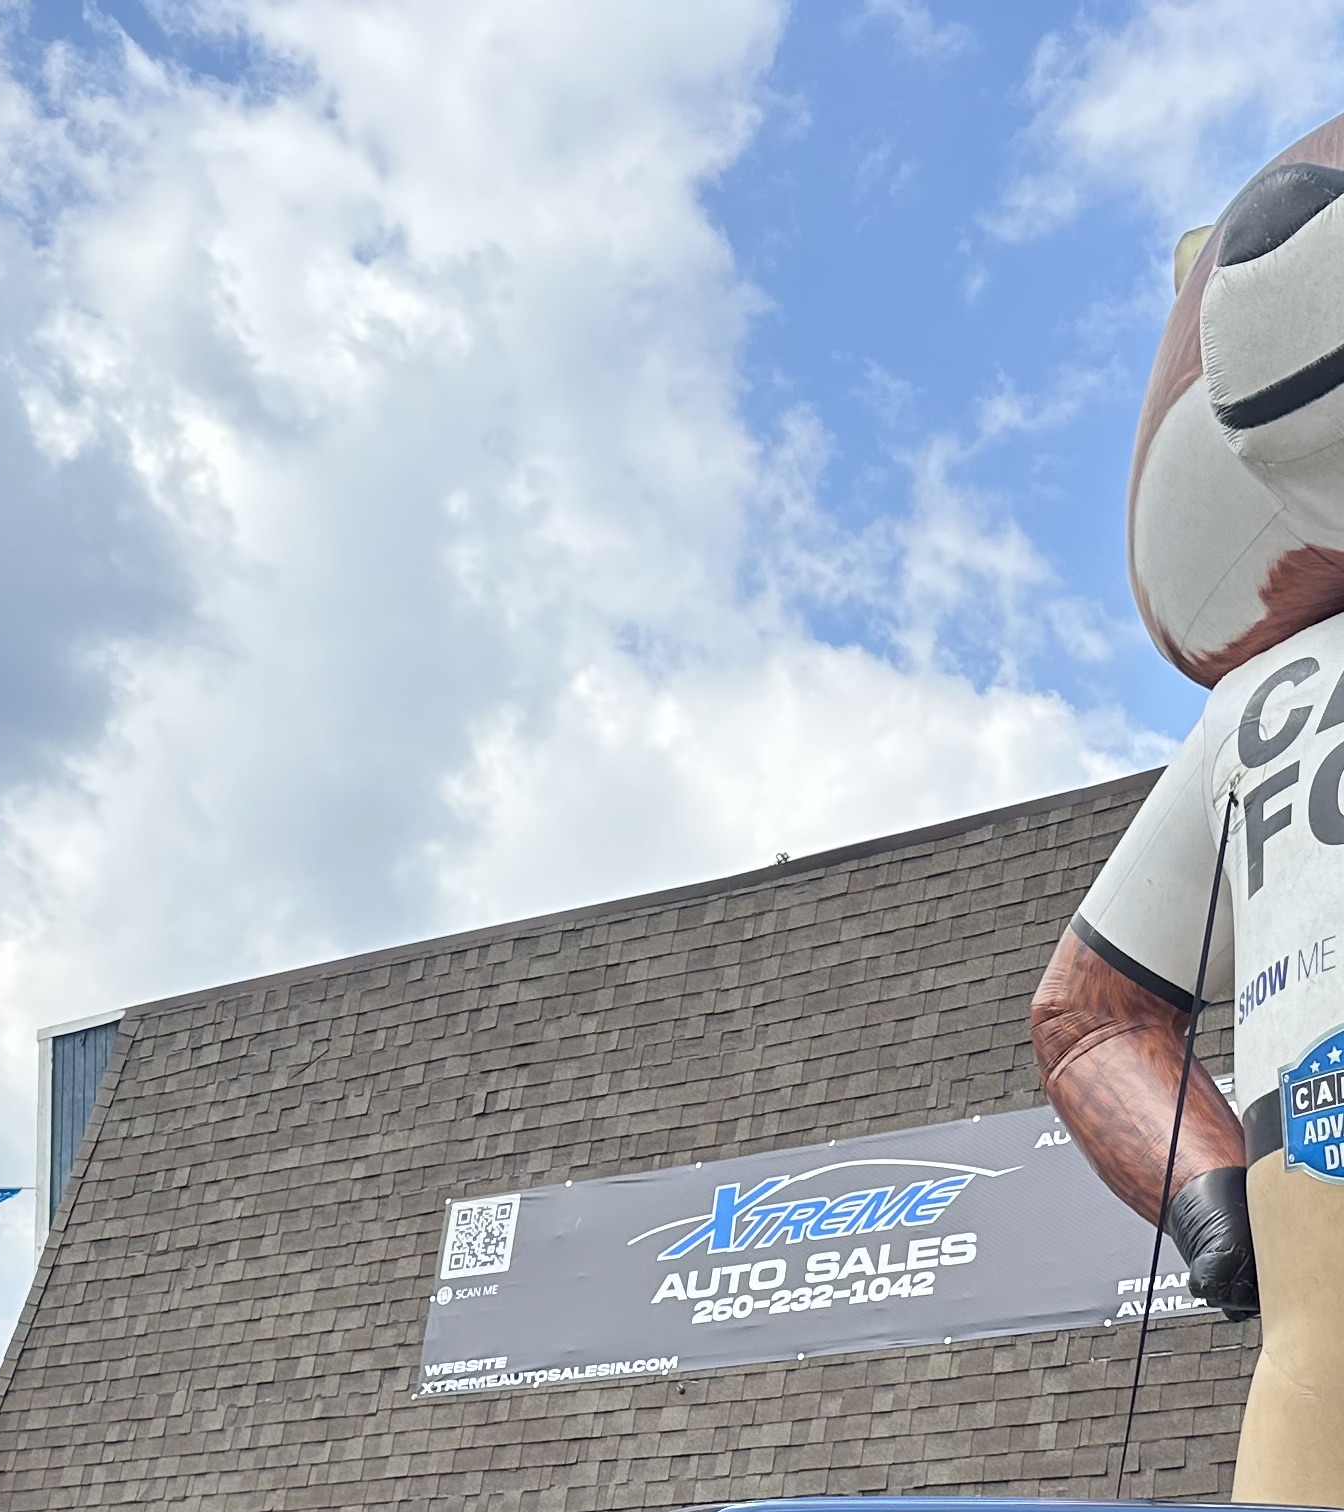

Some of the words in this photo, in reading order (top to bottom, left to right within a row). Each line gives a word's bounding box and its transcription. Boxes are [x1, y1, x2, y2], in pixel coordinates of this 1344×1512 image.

[1238, 956, 1290, 1026] SHOW
[1297, 936, 1337, 983] ME
[650, 1258, 787, 1304] AUTO
[804, 1232, 978, 1284] SALES
[454, 1287, 481, 1300] SCAN
[482, 1284, 499, 1296] ME
[691, 1272, 936, 1325] 260-232-1042
[420, 1355, 679, 1396] XTREMEAUTOSALESIN.COM
[424, 1356, 508, 1377] WEBSITE
